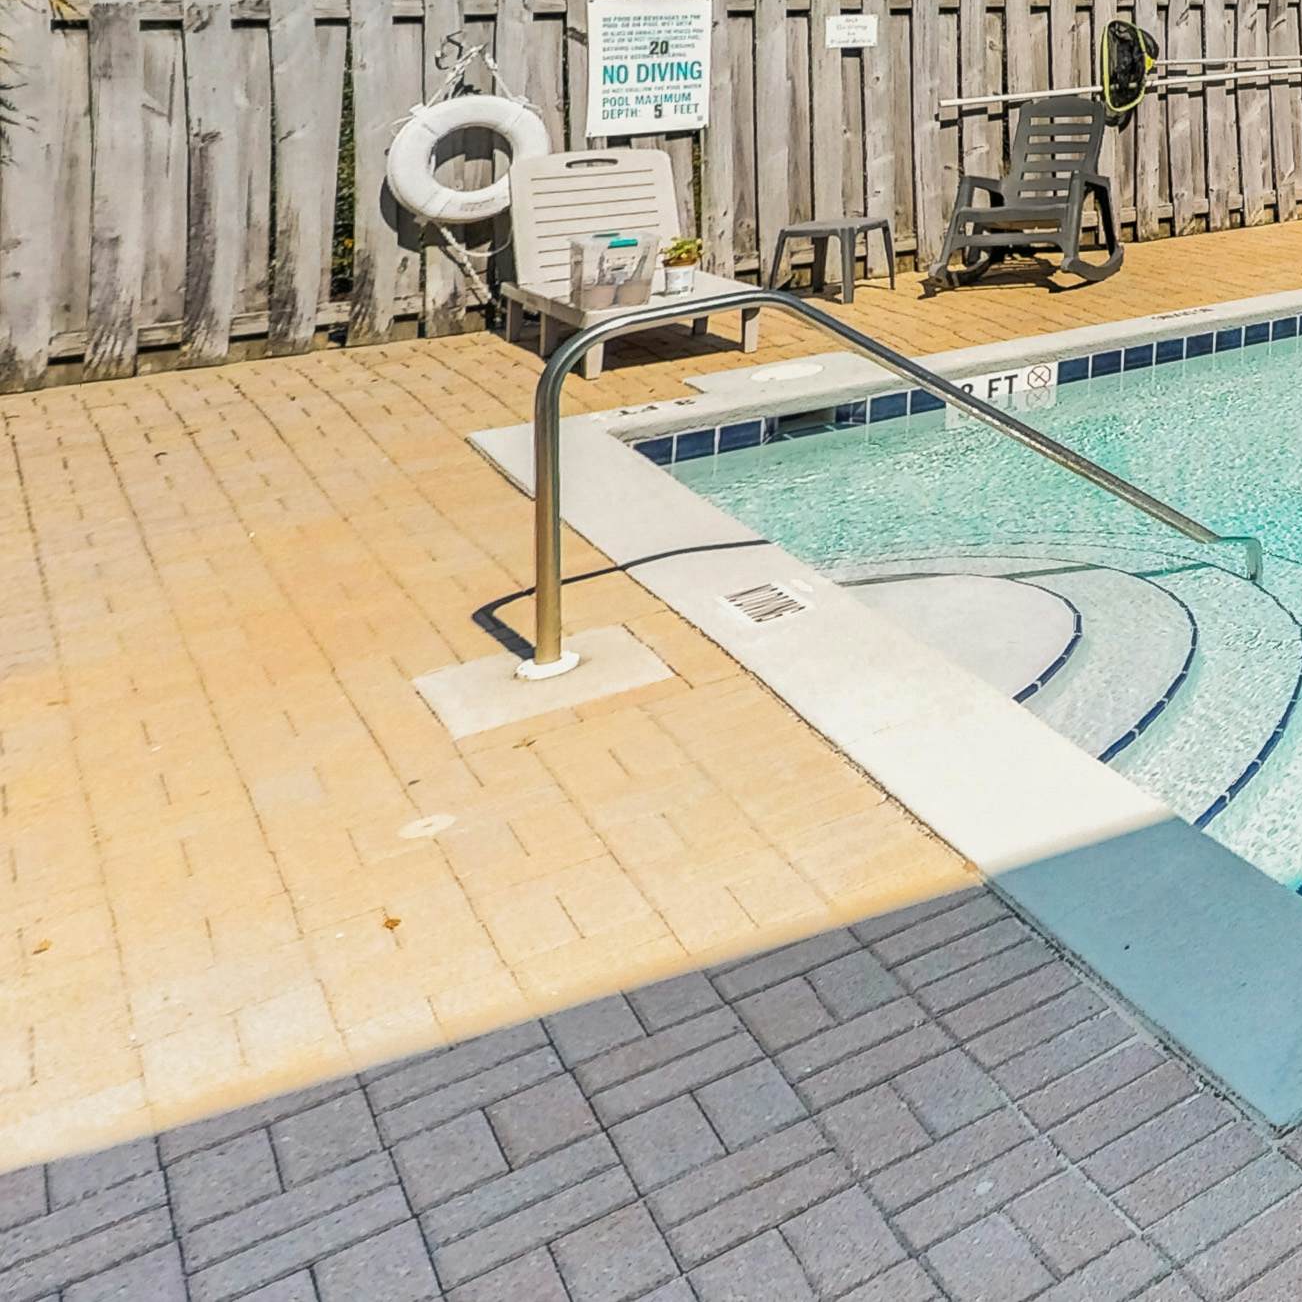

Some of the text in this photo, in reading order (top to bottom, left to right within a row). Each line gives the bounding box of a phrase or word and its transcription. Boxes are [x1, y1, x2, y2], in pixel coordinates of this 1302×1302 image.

[650, 40, 669, 56] 20
[602, 61, 702, 85] NO DIVING
[602, 92, 692, 108] POOL MAXIMUM
[654, 104, 662, 119] 5
[674, 103, 700, 115] FEET
[988, 374, 1018, 398] FT
